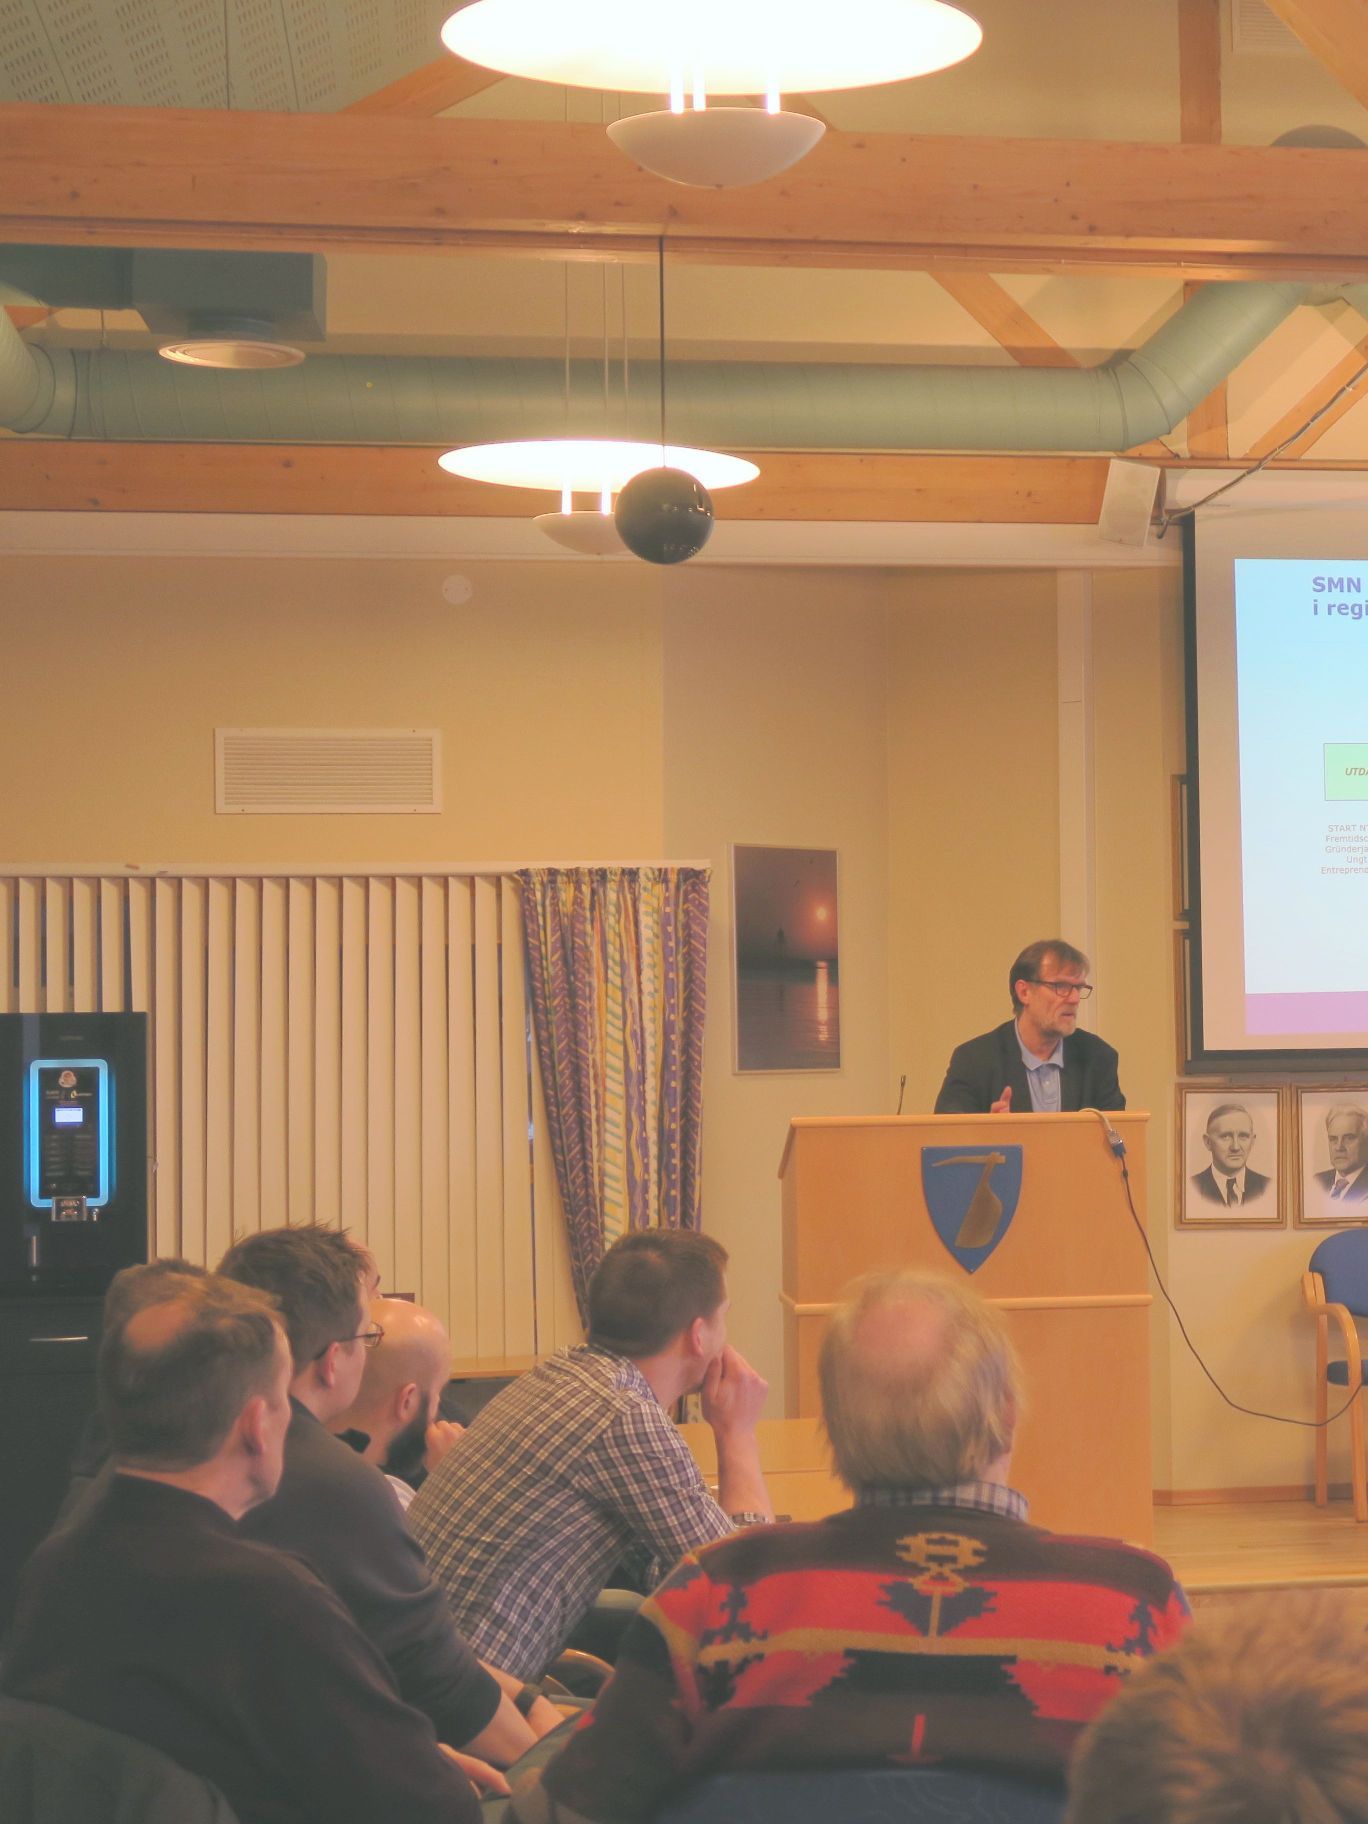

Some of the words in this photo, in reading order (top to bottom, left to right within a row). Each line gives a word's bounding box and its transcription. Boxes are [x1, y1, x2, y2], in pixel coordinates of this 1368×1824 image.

[1312, 577, 1362, 594] SMN
[1313, 600, 1319, 616] i
[1328, 824, 1357, 832] START
[1346, 856, 1368, 865] Ungt
